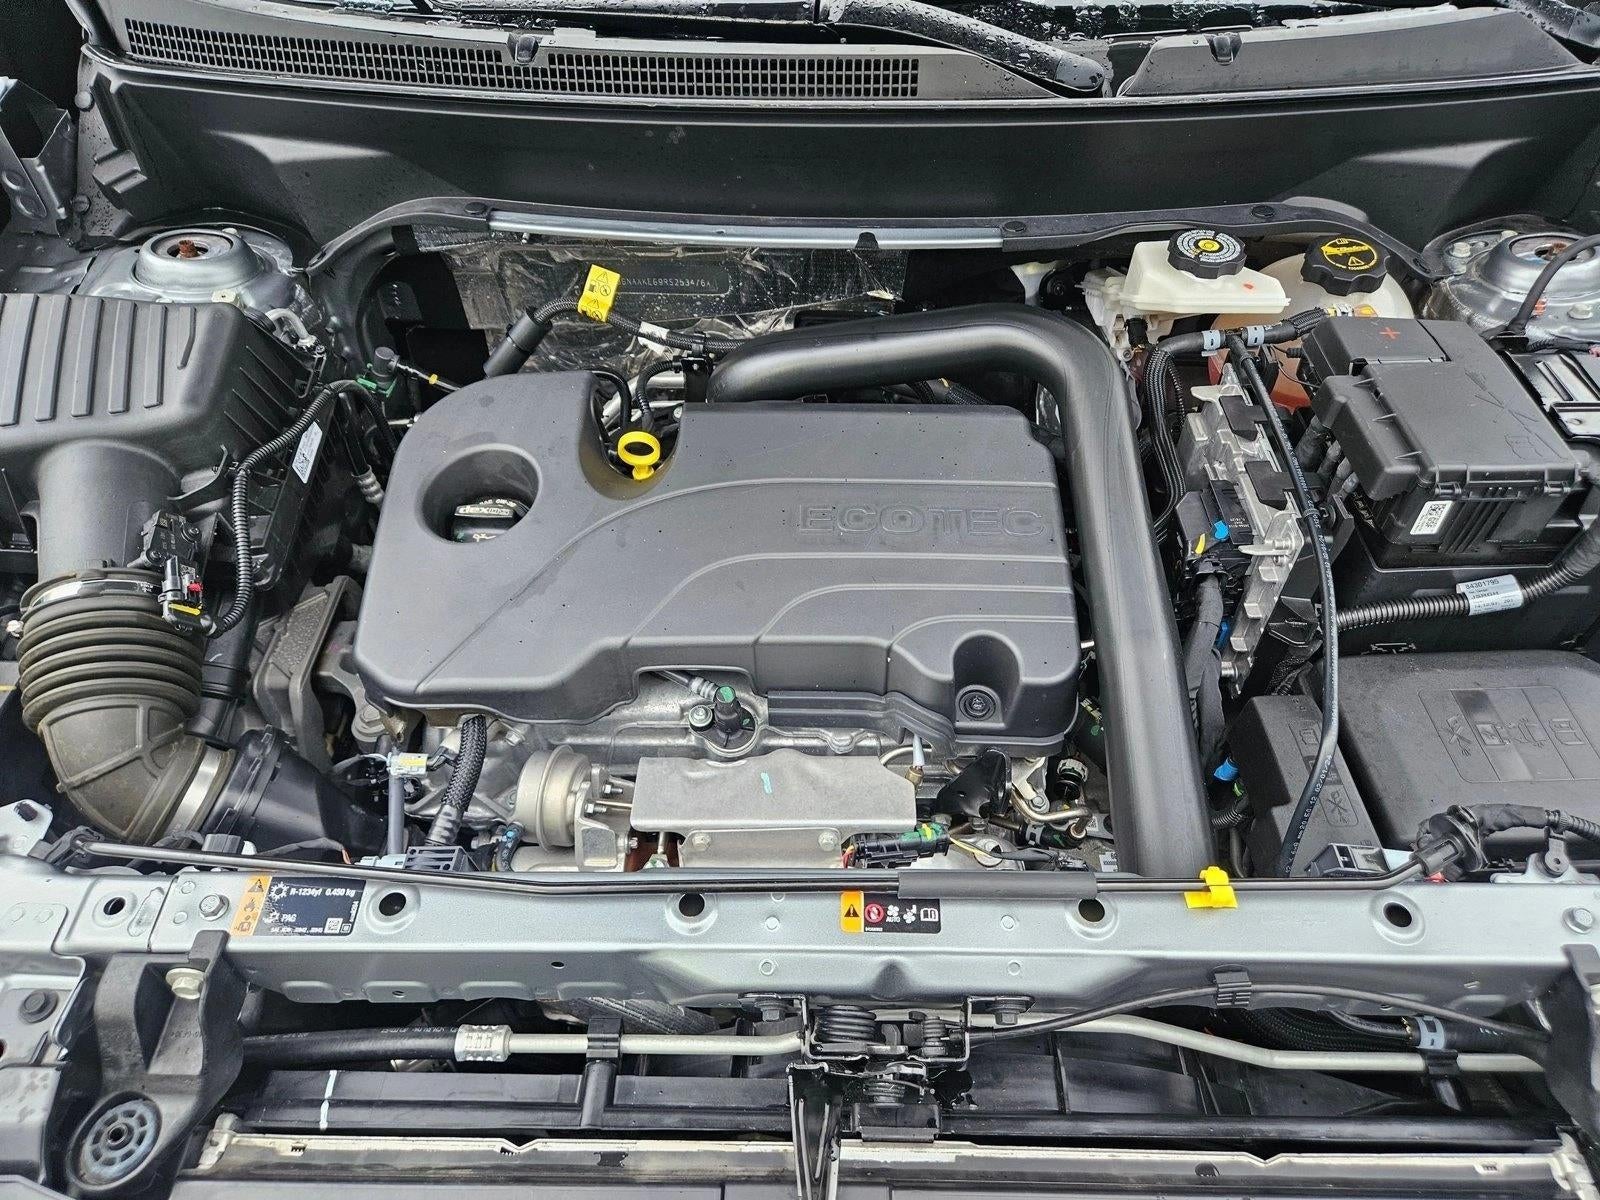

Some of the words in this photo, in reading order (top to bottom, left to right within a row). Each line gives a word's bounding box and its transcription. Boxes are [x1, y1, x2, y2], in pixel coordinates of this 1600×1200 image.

[800, 507, 1045, 536] ECOTEC
[345, 888, 356, 897] kg
[281, 913, 297, 923] PAG
[886, 915, 900, 923] AUTO
